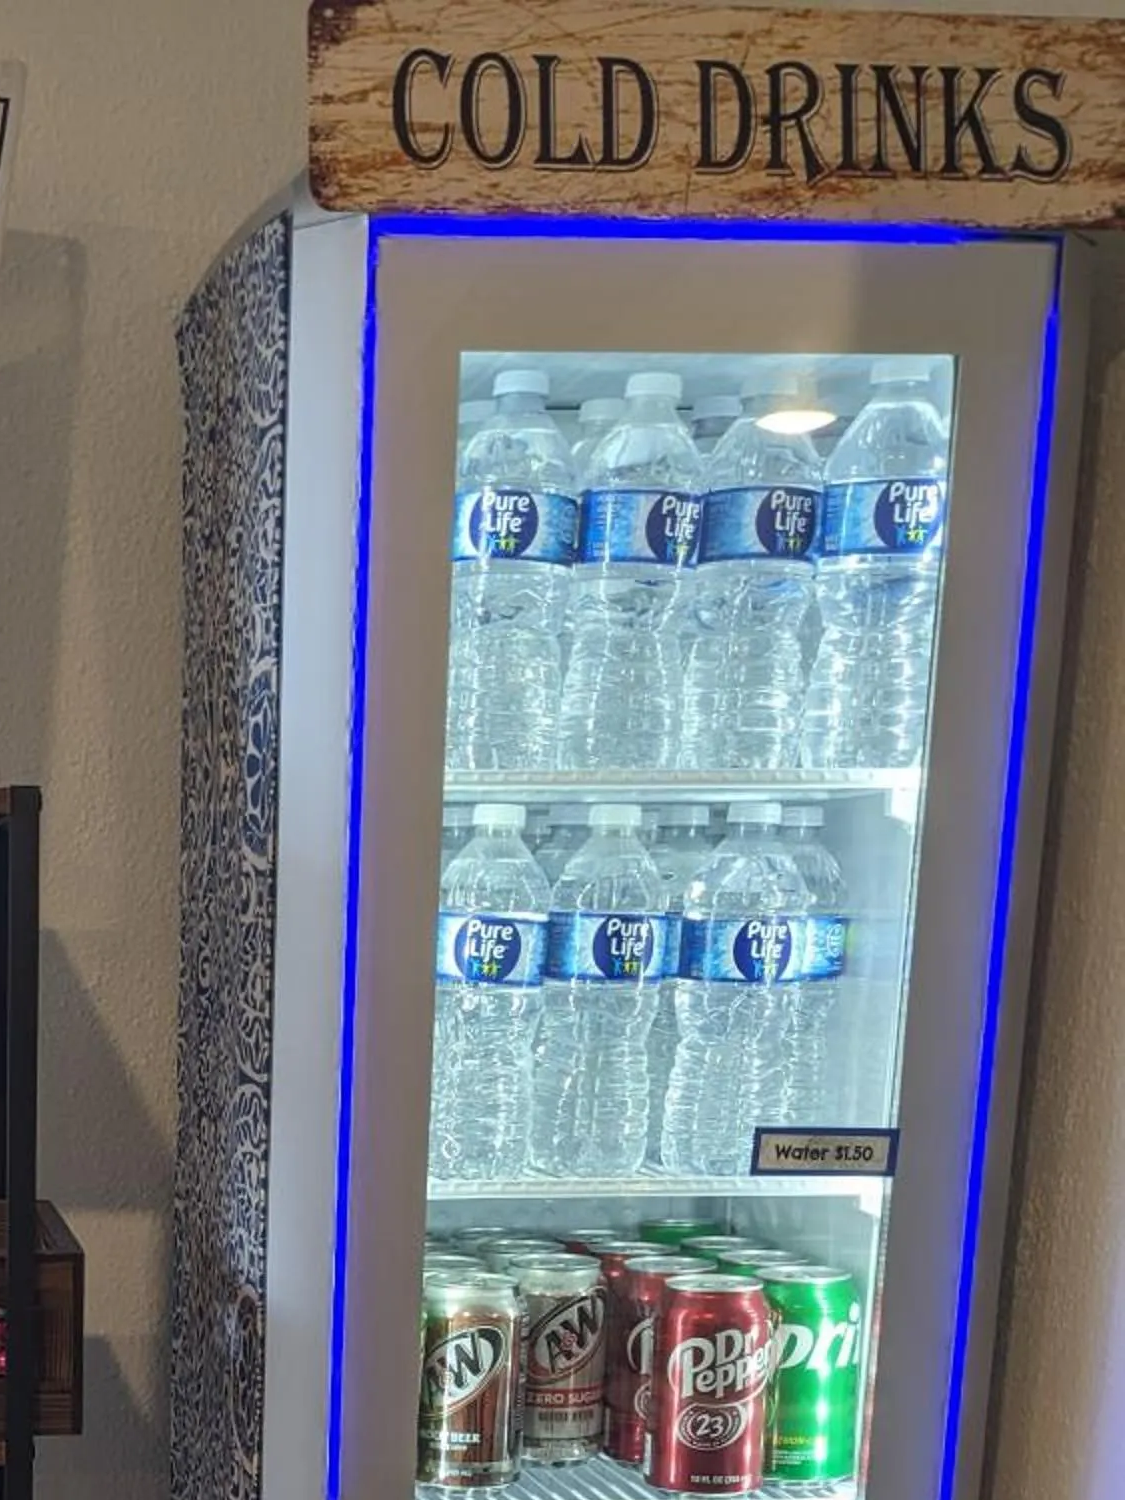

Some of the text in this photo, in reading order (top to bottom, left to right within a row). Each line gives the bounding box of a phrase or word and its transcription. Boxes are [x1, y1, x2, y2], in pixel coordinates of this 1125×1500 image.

[391, 47, 1074, 184] COLD DRINKS
[482, 491, 530, 512] Pure
[770, 490, 812, 513] Pure
[889, 481, 939, 507] Pure
[661, 495, 700, 519] Pure
[893, 502, 933, 529] Life
[485, 511, 524, 535] Life
[664, 516, 695, 543] Life
[775, 511, 808, 537] Life
[467, 919, 514, 941] Pure
[606, 917, 650, 939] Pure
[746, 921, 788, 940] Pure
[469, 938, 506, 963] Life
[610, 937, 644, 962] Life
[750, 938, 783, 961] Life
[774, 1144, 875, 1162] Water $1.50
[544, 1294, 600, 1374] A&W
[714, 1328, 756, 1366] Dr
[695, 1413, 725, 1438] 23
